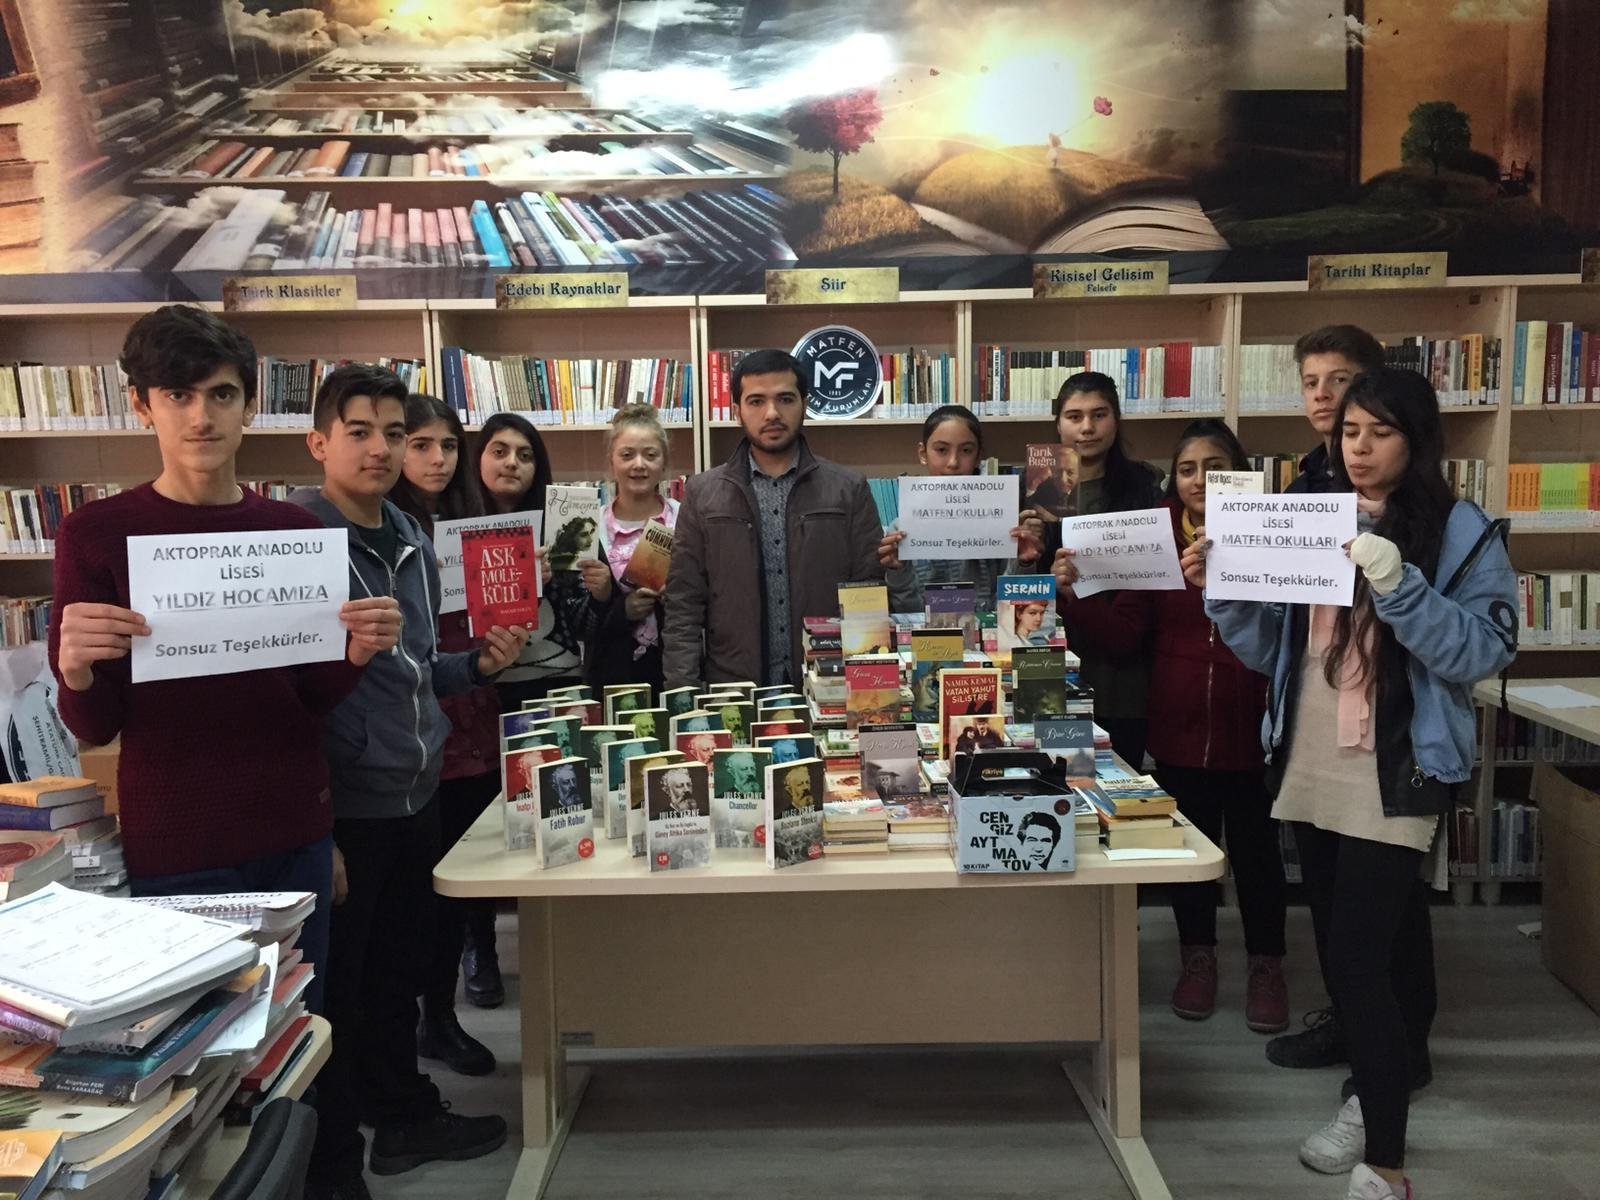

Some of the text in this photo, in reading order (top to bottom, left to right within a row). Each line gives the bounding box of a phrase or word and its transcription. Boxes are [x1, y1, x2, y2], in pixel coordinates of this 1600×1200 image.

[1325, 263, 1431, 279] Tarihi Kitaplar
[278, 283, 342, 298] Klasikler
[504, 282, 622, 298] Edebi Kaynaklar
[806, 336, 866, 359] MATFEN
[1028, 446, 1052, 457] Tarık
[1028, 457, 1057, 467] Buğra
[911, 482, 1005, 492] AKTOPRAK ANADOLU
[945, 494, 971, 504] LİSESİ
[912, 508, 1004, 518] MATFEN OKULLARI
[1221, 502, 1339, 513] AKTOPRAK ANADOLU
[1072, 516, 1158, 530] AKTOPRAK ANADOLU
[1262, 516, 1294, 529] LİSESİ
[910, 538, 1005, 549] Sonsuz Teşekkürler.
[1221, 534, 1337, 549] MATFEN OKULLARI
[153, 541, 323, 561] AKTOPRAK ANADOLU
[220, 563, 265, 580] LİSESİ
[1220, 571, 1338, 587] Sonsuz Teşekkürler.
[444, 587, 465, 598] Sons
[1004, 580, 1050, 597] ŞERMİN
[152, 584, 329, 611] YILDIZ HOCAMIZA
[155, 632, 323, 658] Sonsuz Teşekkürler.
[945, 676, 995, 688] NAMIK KEMAL
[945, 684, 996, 696] VATAN YAHUT
[723, 791, 763, 800] JULES VERNE
[980, 811, 1009, 824] CEN
[989, 824, 1014, 836] GİZ
[970, 836, 999, 848] AYT
[992, 847, 1018, 860] MA
[1001, 860, 1032, 871] TOV
